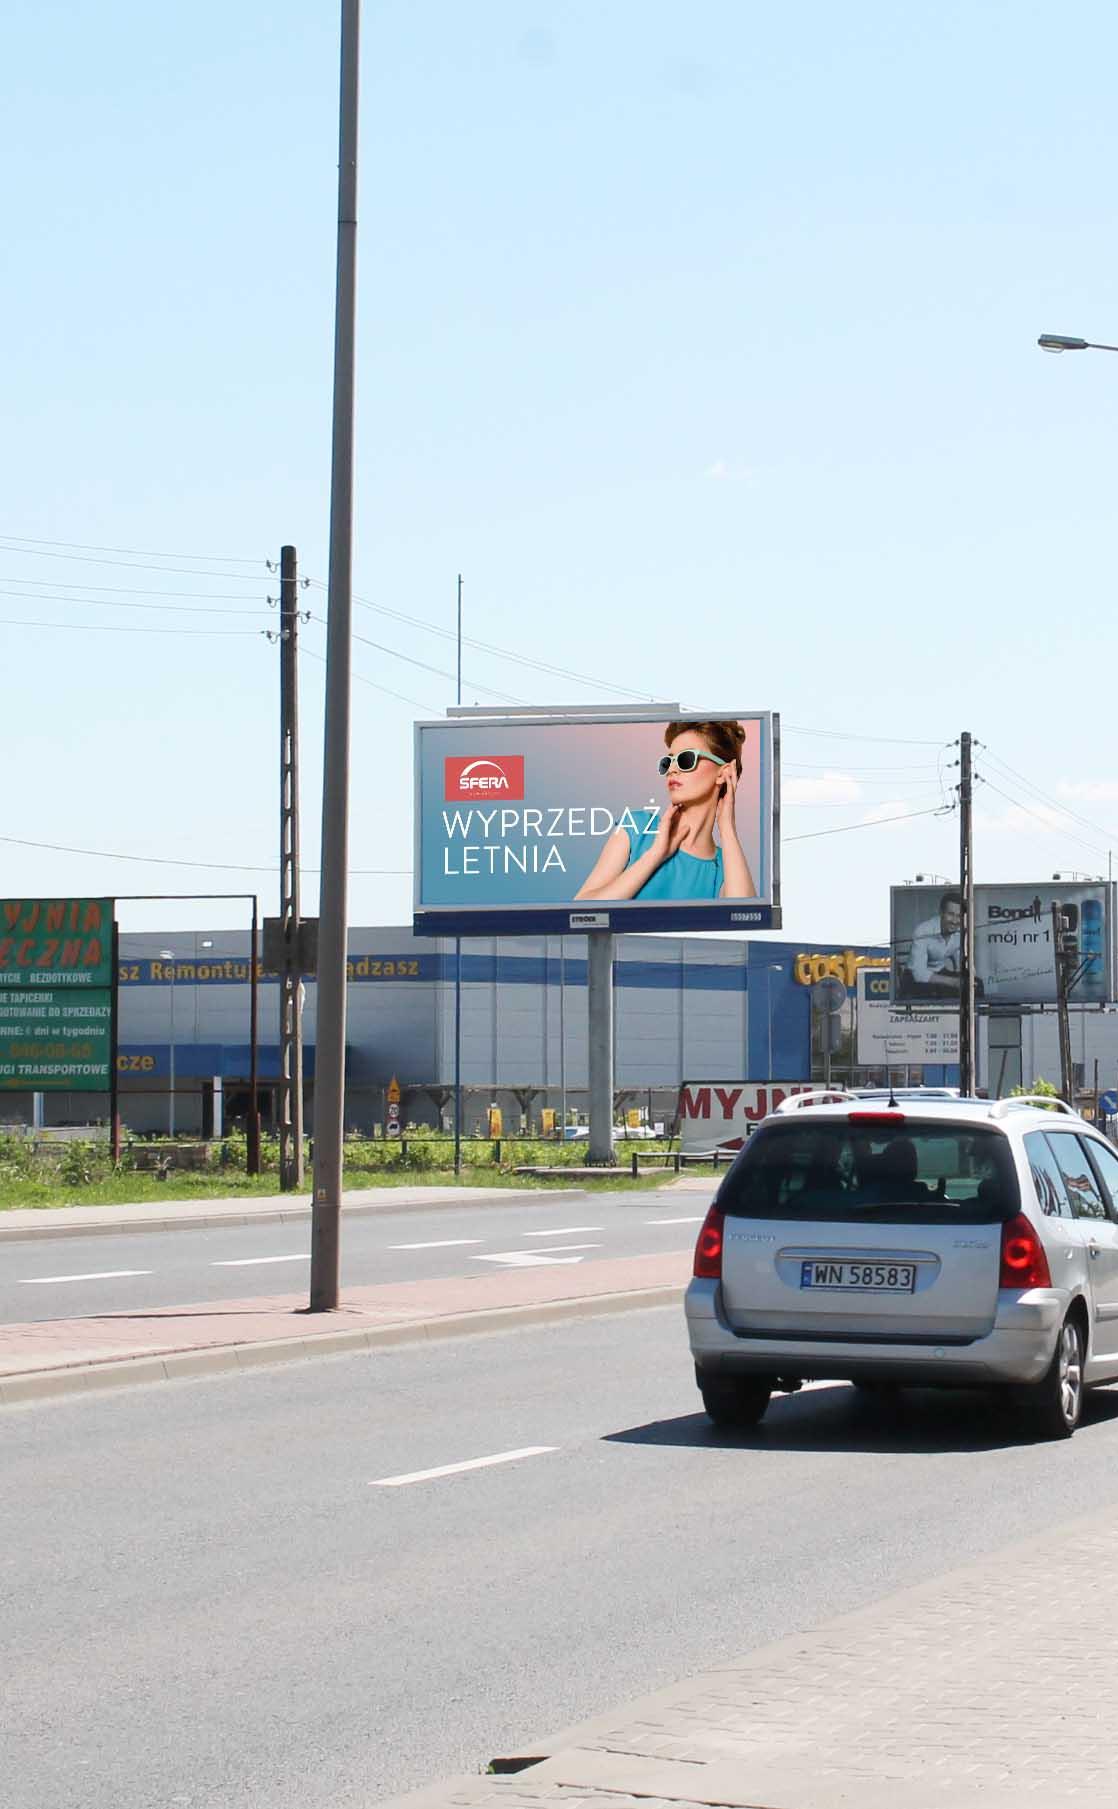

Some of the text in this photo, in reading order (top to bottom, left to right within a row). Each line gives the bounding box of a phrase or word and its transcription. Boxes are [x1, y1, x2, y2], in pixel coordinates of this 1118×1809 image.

[459, 776, 509, 789] SFERA
[442, 798, 661, 839] WYPRZEDAŻ
[444, 844, 567, 875] LETNIA
[988, 930, 1051, 946] mój nr 1
[63, 1026, 105, 1038] tygodniu
[17, 1064, 109, 1075] TRANSPORTOWE
[815, 1264, 912, 1287] WN 58583
